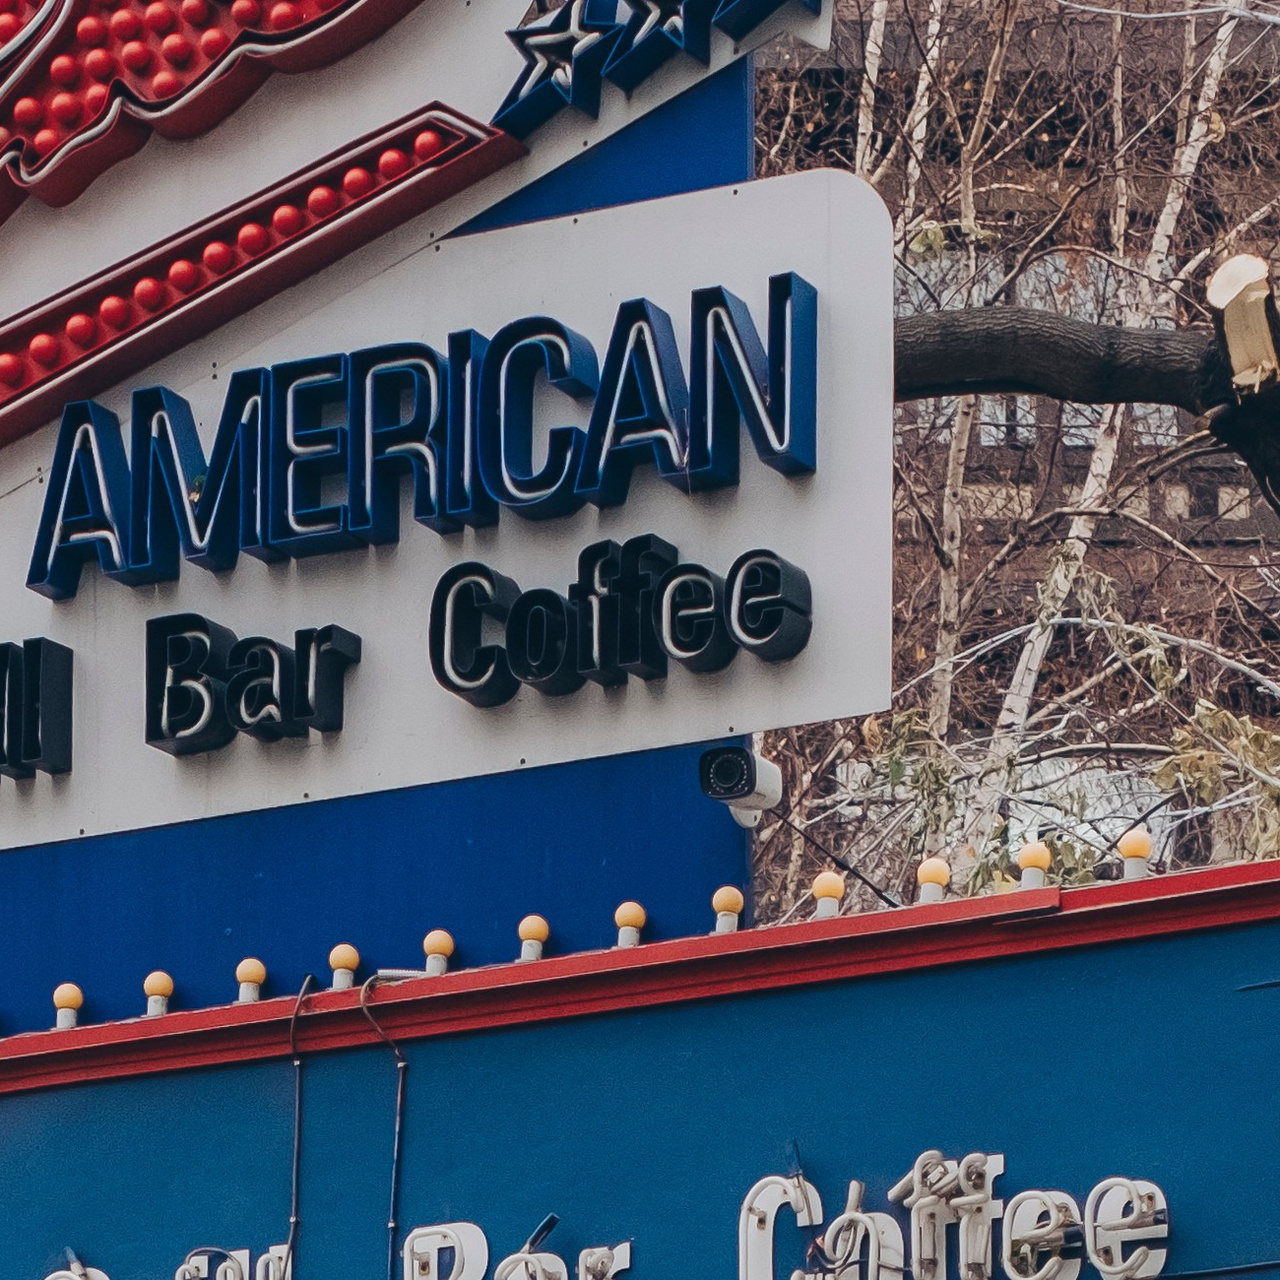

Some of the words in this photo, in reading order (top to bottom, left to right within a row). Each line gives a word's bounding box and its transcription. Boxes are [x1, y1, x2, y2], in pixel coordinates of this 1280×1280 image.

[26, 272, 817, 600] AMERICAN
[145, 613, 361, 755] Bar
[429, 533, 812, 708] Coffee
